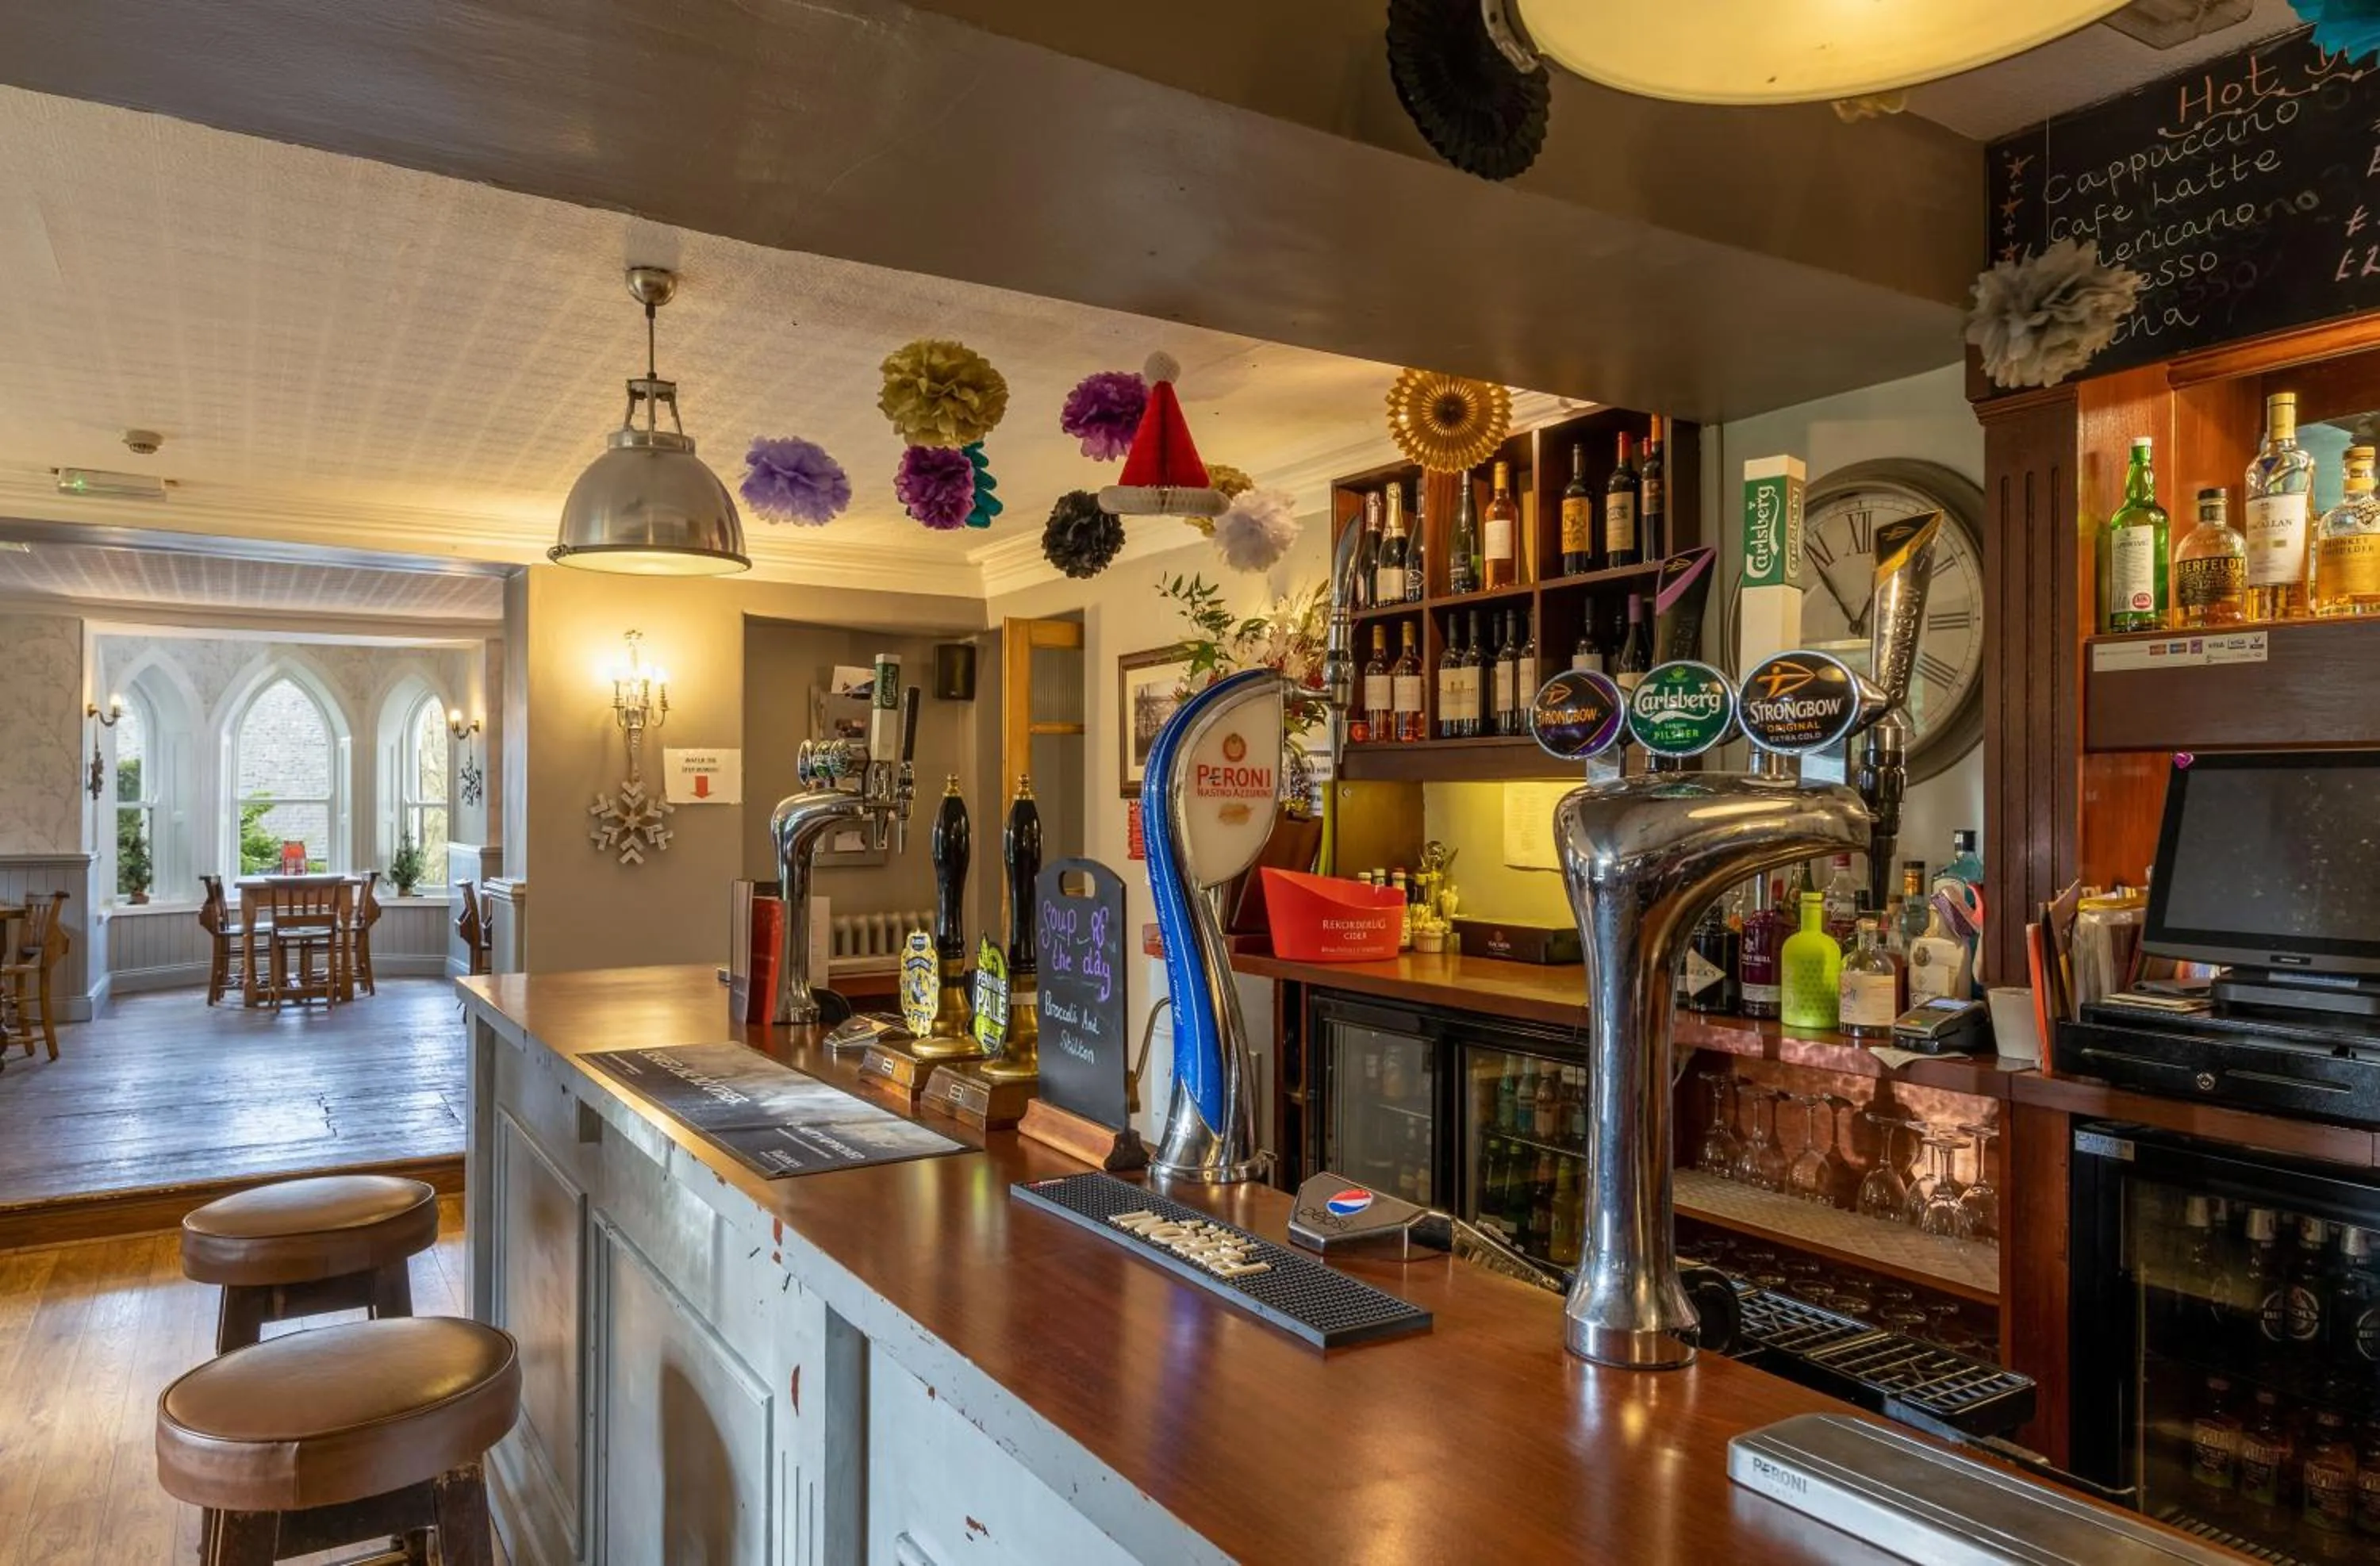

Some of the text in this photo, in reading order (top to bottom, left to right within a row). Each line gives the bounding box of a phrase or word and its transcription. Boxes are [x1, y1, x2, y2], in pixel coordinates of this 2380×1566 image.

[2178, 54, 2279, 124] Hot
[2043, 99, 2299, 205] Cappuccino
[2051, 148, 2282, 243] Cafe Latte
[2096, 202, 2255, 268] ericano
[2136, 251, 2219, 292] esso
[2108, 305, 2200, 346] cha
[1746, 485, 1779, 579] Carlsberg
[1634, 683, 1722, 720] Carlsberg
[1749, 697, 1841, 725] STRONGBOW
[1767, 720, 1821, 733] ORIGINAL
[1196, 763, 1271, 789] PERONI
[1040, 900, 1077, 950] Soup
[1052, 938, 1072, 972] the
[976, 985, 1007, 1027] PALE
[1752, 1457, 1807, 1495] PERONI
